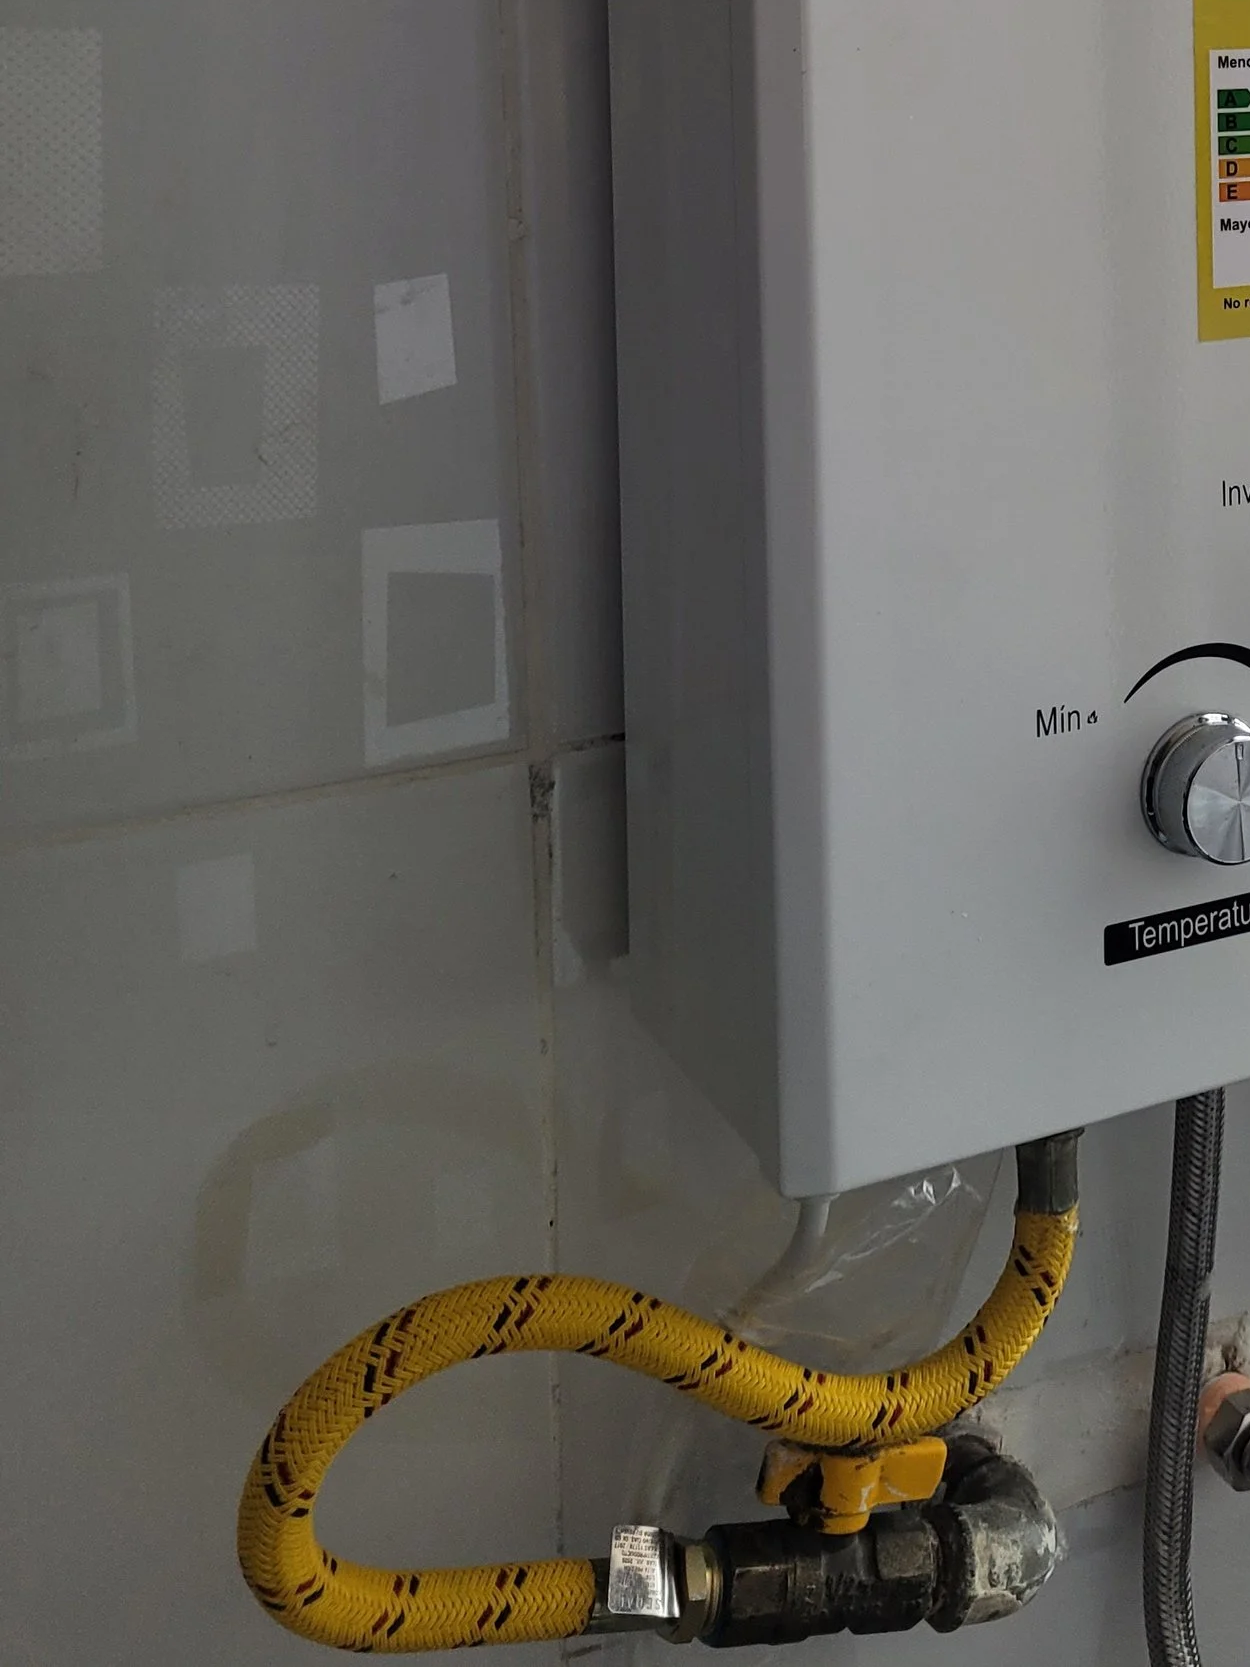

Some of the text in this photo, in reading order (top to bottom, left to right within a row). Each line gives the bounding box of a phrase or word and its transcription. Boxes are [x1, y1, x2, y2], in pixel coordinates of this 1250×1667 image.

[1224, 93, 1237, 106] A
[1226, 116, 1237, 129] B
[1226, 139, 1238, 152] C
[1226, 161, 1238, 177] D
[1227, 183, 1238, 200] E
[1224, 298, 1240, 310] No
[1036, 705, 1080, 738] Mín
